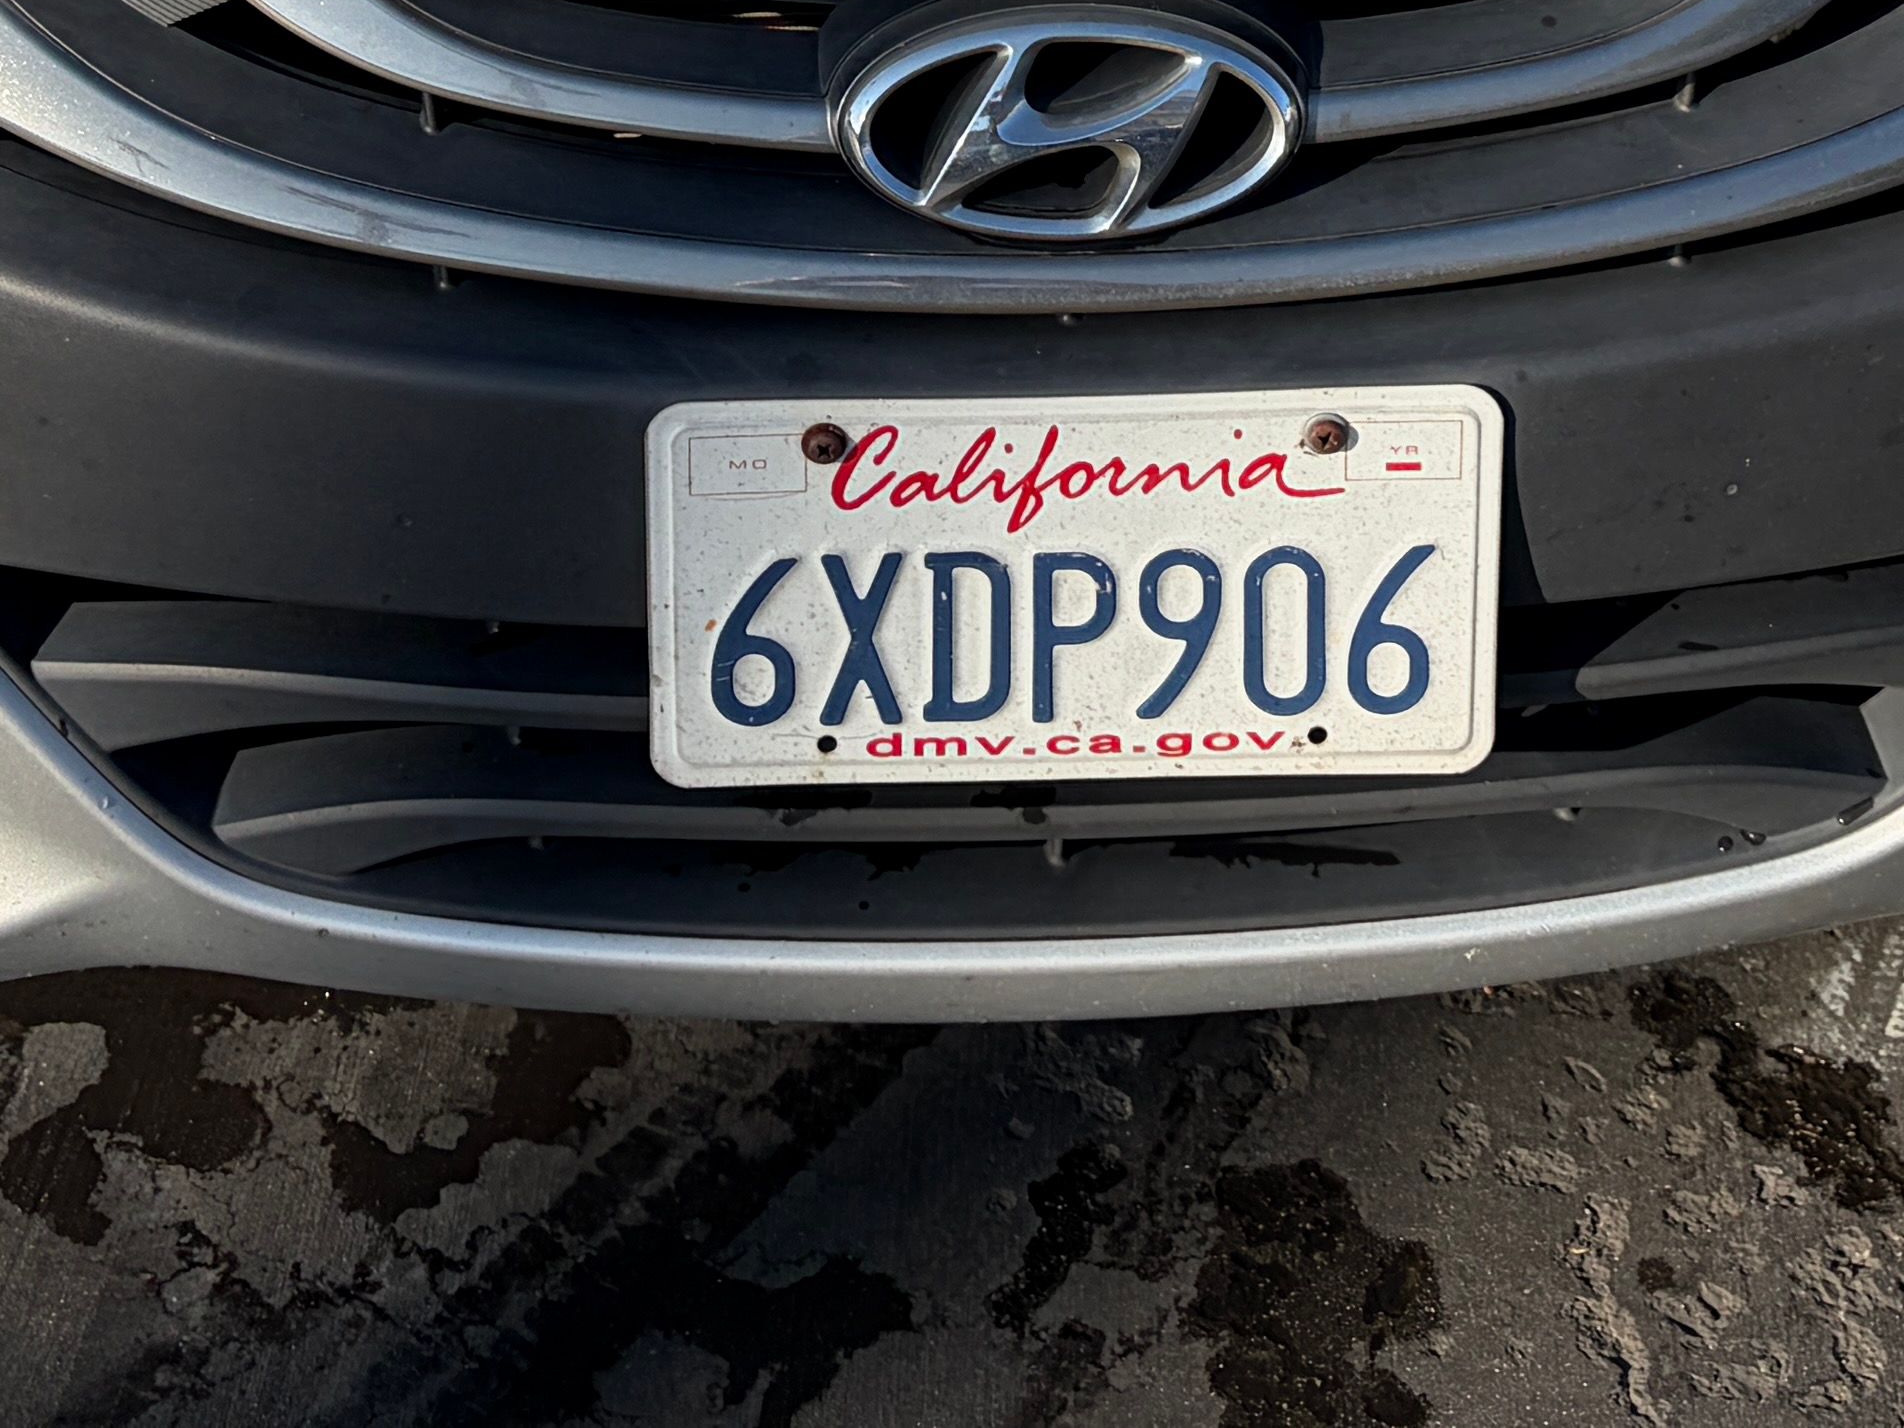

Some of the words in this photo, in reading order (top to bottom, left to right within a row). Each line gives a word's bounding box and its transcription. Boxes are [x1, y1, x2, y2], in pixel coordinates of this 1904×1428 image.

[729, 459, 767, 470] MO
[830, 423, 1346, 532] California
[1390, 445, 1419, 455] YR
[711, 544, 1436, 727] 6XDP906
[865, 729, 1284, 759] dmv.ca.gov
